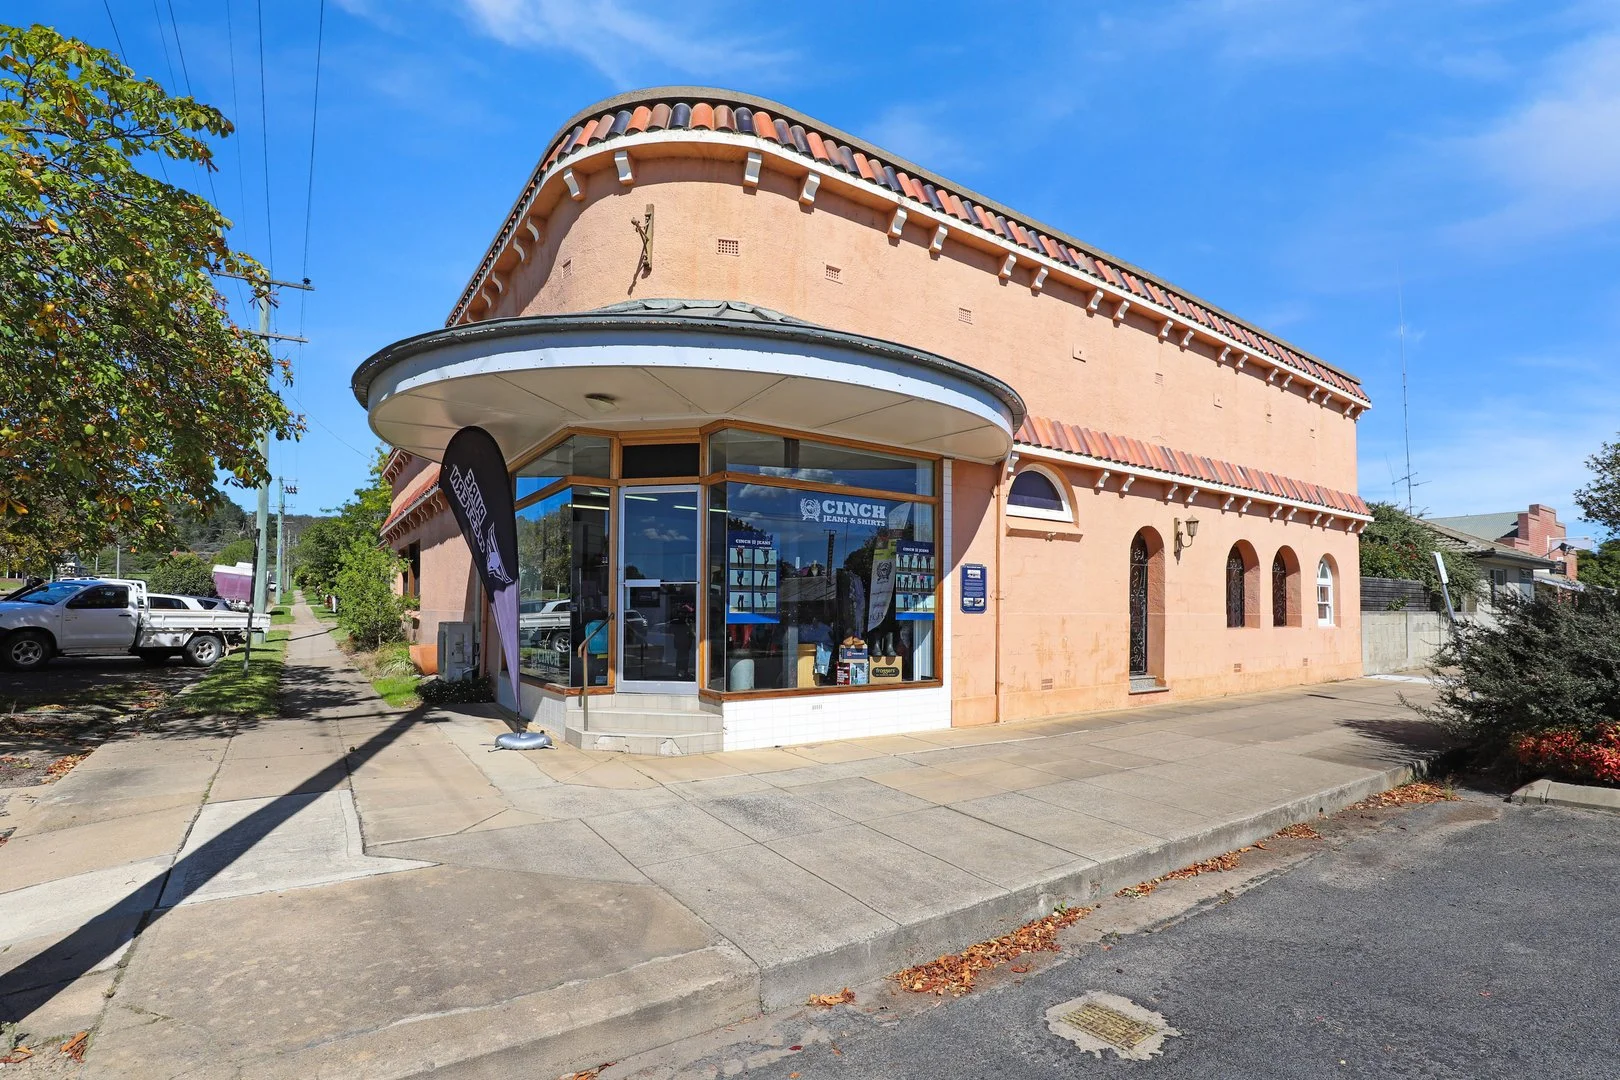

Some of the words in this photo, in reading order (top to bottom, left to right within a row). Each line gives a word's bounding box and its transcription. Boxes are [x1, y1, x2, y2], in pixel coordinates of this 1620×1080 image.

[822, 500, 886, 519] CINCH
[823, 515, 848, 523] JEANS
[857, 518, 886, 527] SHIRTS
[537, 650, 560, 667] CINCH
